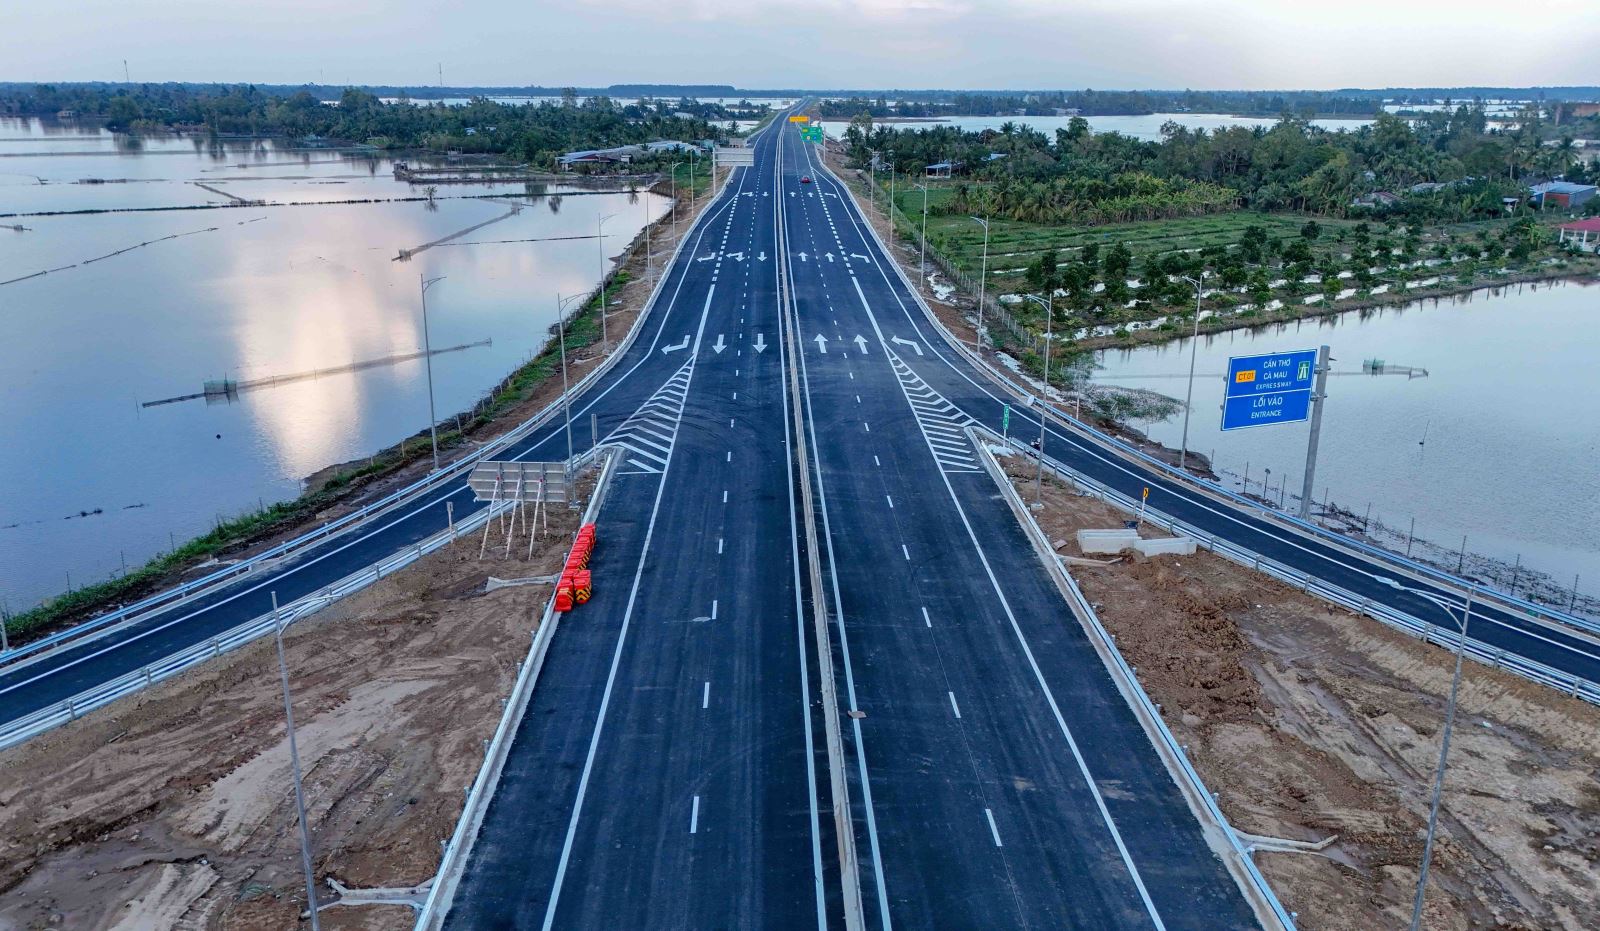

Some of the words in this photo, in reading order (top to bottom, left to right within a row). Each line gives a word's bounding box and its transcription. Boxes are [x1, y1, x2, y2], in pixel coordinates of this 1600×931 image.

[1273, 370, 1288, 379] MAU
[1255, 382, 1292, 390] EXPRESSWAY
[1267, 395, 1283, 406] VÀO
[1251, 409, 1282, 418] ENTRANCE
